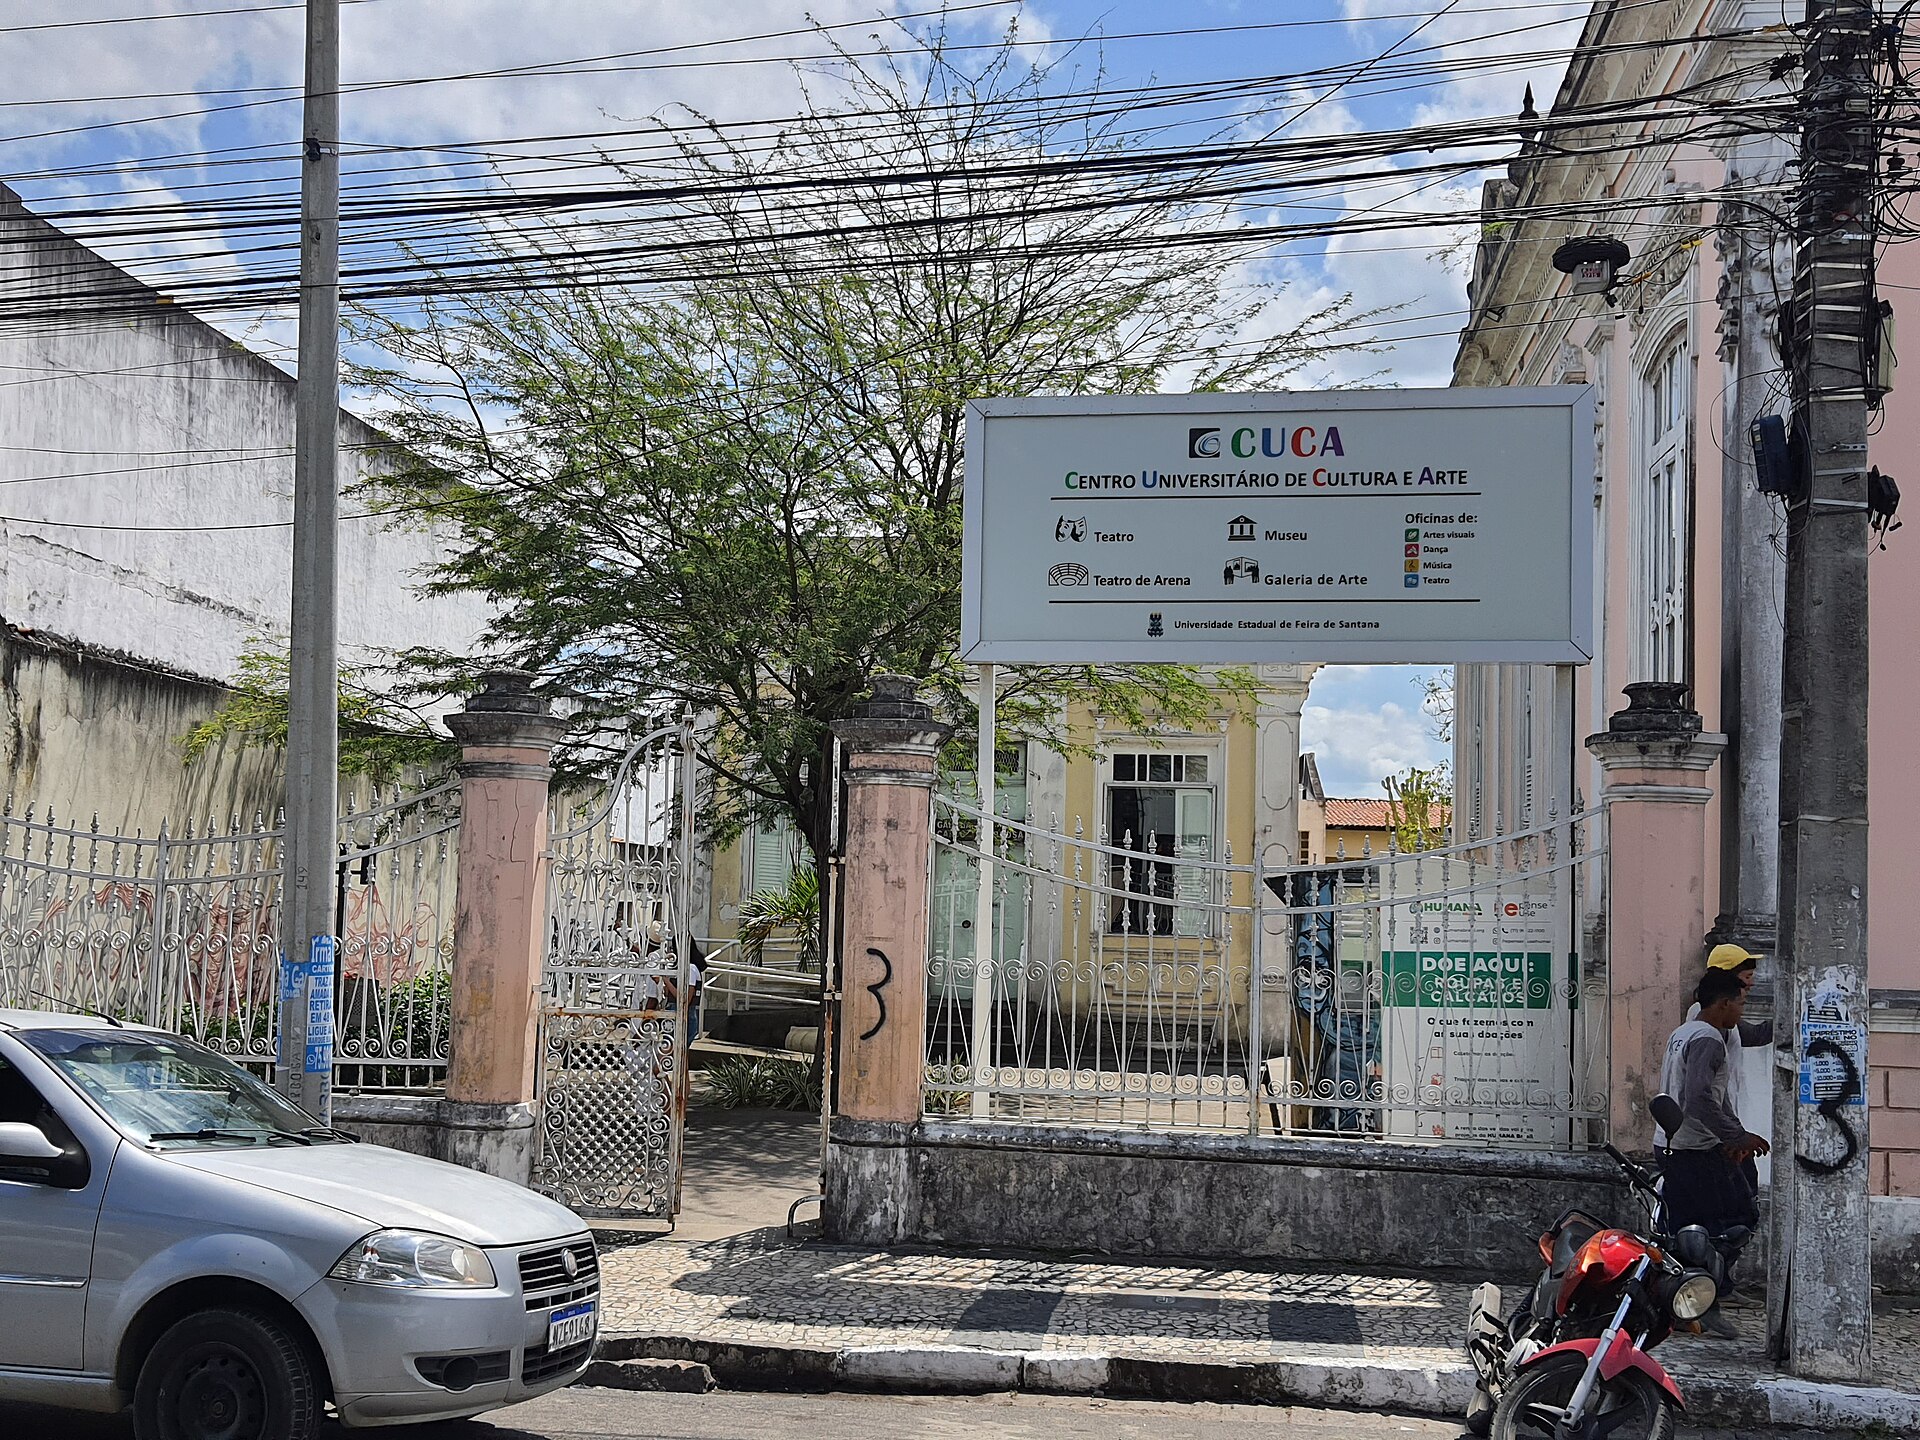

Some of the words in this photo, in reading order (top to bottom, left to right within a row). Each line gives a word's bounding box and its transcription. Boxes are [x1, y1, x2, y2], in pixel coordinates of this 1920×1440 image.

[1231, 426, 1345, 459] CUCA
[1065, 471, 1137, 491] CENTRO
[1142, 469, 1280, 489] UNIVERSITÁRIO
[1285, 472, 1308, 488] DE
[1313, 468, 1398, 487] CULTURA
[1403, 471, 1414, 487] E
[1418, 467, 1469, 487] ARTE
[1405, 512, 1455, 524] Oficinas
[1457, 512, 1478, 524] de:
[1093, 531, 1135, 544] Teatro
[1264, 530, 1308, 542] Museu
[1423, 531, 1446, 539] Artes
[1447, 531, 1475, 539] visuais
[1423, 545, 1449, 555] Dança
[1423, 561, 1453, 570] Música
[1093, 575, 1133, 587] Teatro
[1135, 574, 1151, 587] de
[1153, 574, 1191, 586] Arena
[1264, 573, 1313, 588] Galeria
[1317, 573, 1334, 586] de
[1337, 574, 1368, 586] Arte
[1423, 576, 1450, 585] Teatro
[1174, 620, 1234, 630] Universidade
[1237, 620, 1277, 630] Estadual
[1279, 620, 1292, 629] de
[1295, 620, 1320, 629] Feira
[1323, 620, 1336, 629] de
[1338, 620, 1380, 629] Santana
[1421, 957, 1467, 972] DOE
[1512, 978, 1522, 990] E
[860, 948, 892, 1040] 3
[1427, 1017, 1435, 1026] O
